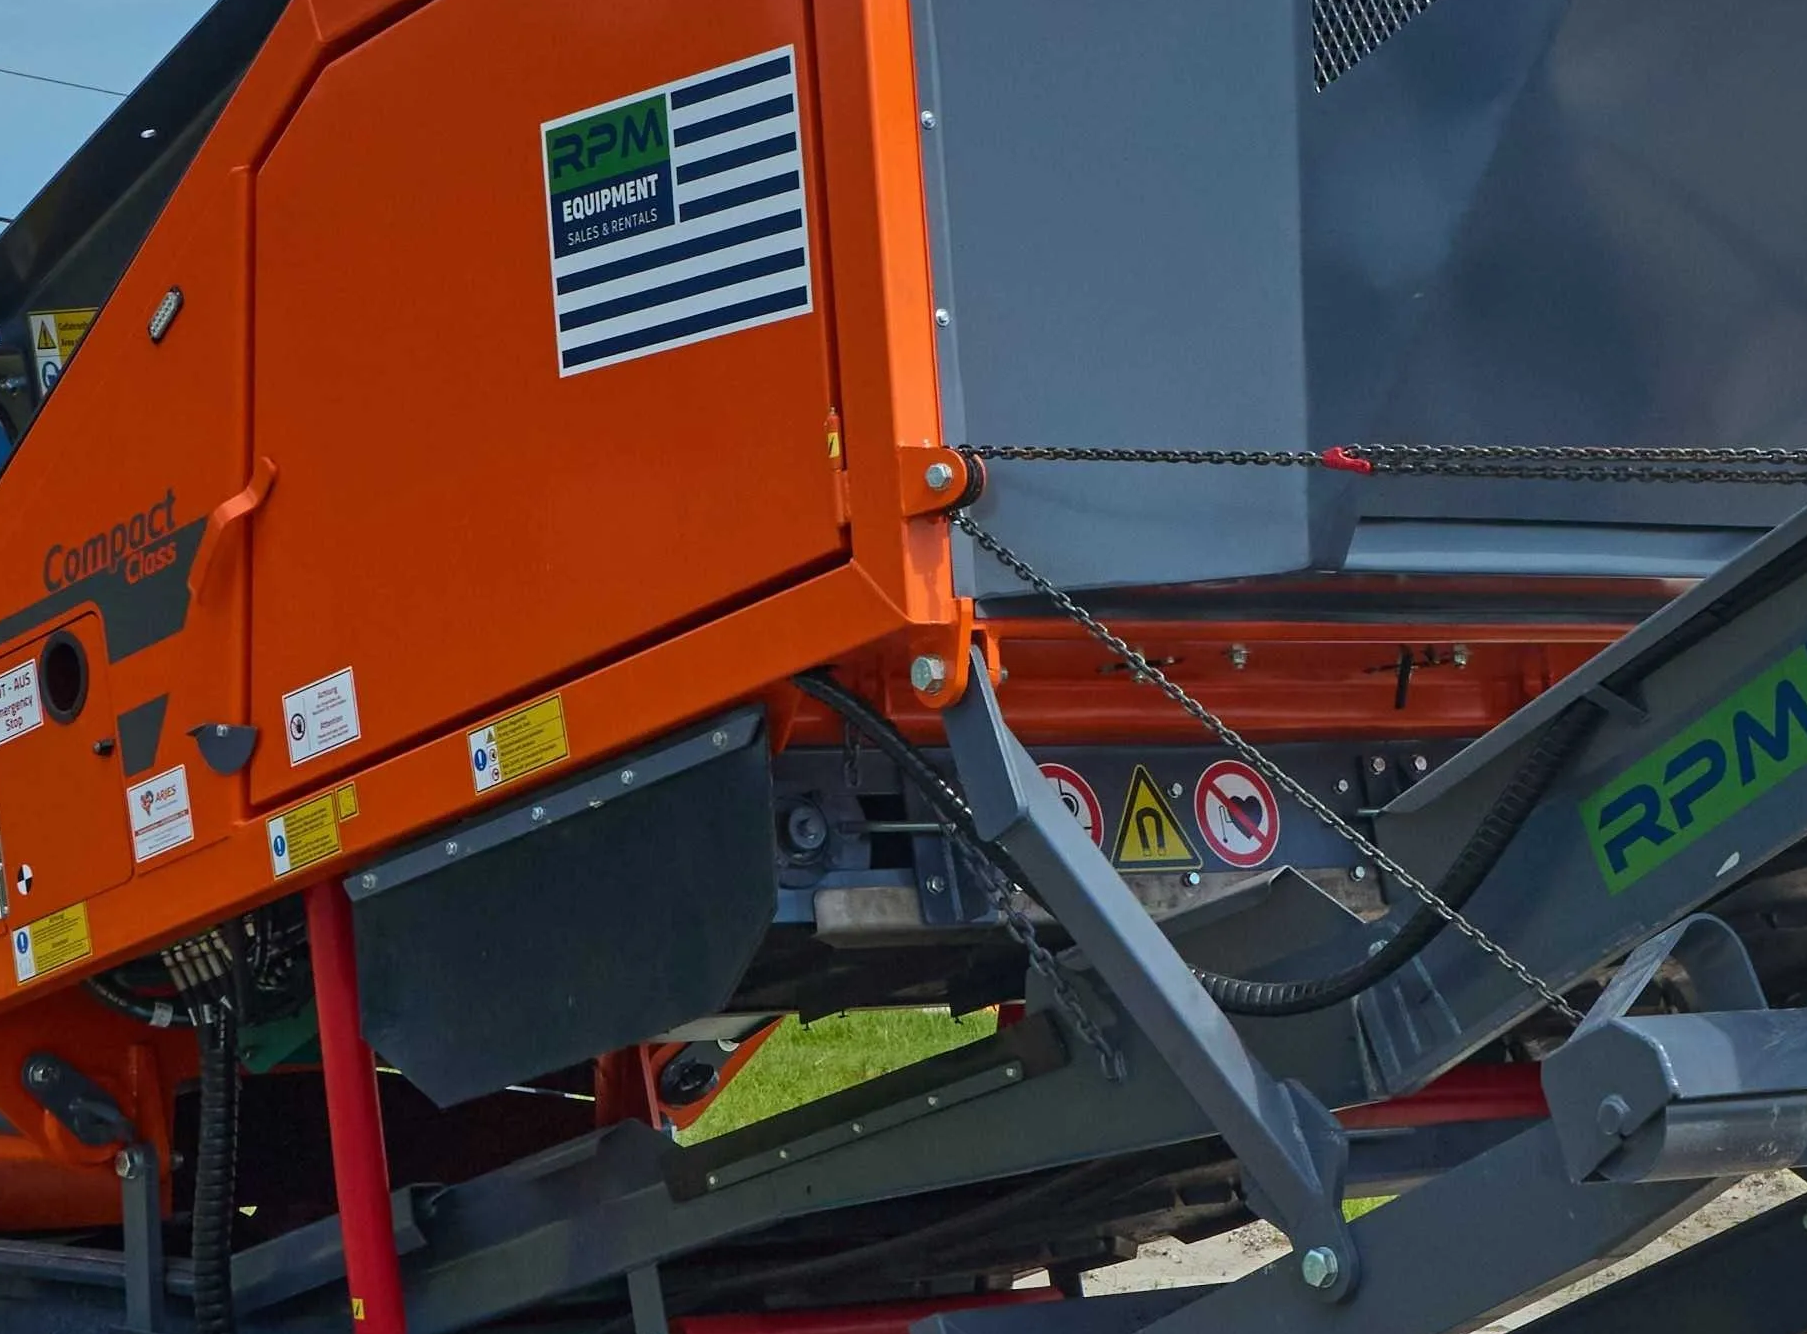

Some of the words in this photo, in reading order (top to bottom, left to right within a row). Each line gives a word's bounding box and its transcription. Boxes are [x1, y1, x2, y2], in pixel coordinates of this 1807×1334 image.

[553, 107, 664, 179] RPM
[562, 173, 659, 223] EQUIPMENT
[567, 225, 600, 246] SALES
[602, 222, 610, 236] &
[611, 208, 658, 233] RENTALS
[43, 487, 176, 593] Compact
[124, 542, 176, 585] Class
[14, 671, 31, 692] AUS
[5, 716, 24, 732] Stop
